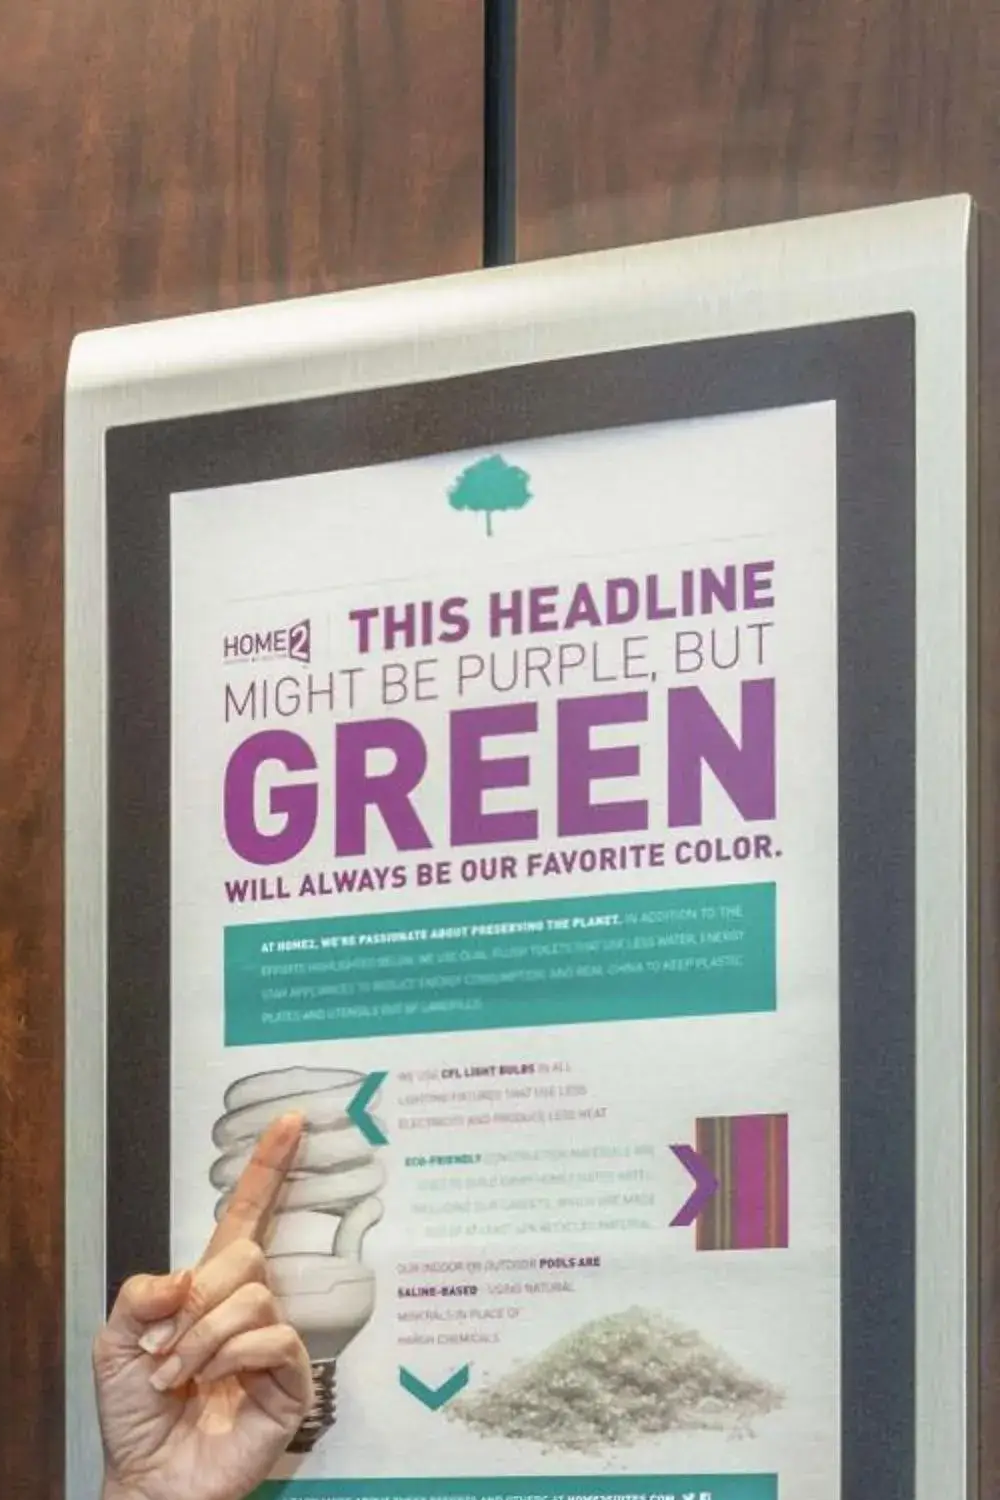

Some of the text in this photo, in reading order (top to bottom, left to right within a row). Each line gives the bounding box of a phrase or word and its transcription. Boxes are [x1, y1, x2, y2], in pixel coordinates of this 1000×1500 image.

[348, 560, 775, 653] THIS HEADLINE
[223, 617, 311, 664] HOME2
[224, 622, 775, 722] MIGHT BE PURPLE, BUT
[223, 677, 776, 866] GREEN
[225, 834, 784, 903] WILL ALWAYS BE OUR FAVORITE COLOR.
[260, 940, 275, 954] AT
[320, 934, 358, 949] WE'RE
[358, 929, 428, 946] PASSIONATE
[430, 925, 468, 940] ABOUT
[470, 920, 544, 937] PRESERVING
[546, 917, 570, 931] THE
[440, 1067, 462, 1080] CFL
[464, 1065, 496, 1078] LIGHT
[498, 1063, 536, 1076] BULBS
[404, 1153, 482, 1168] ECO-FRIENDLY
[538, 1256, 576, 1269] POOLS
[578, 1255, 600, 1267] ARE
[398, 1285, 478, 1298] SALINE-BASED
